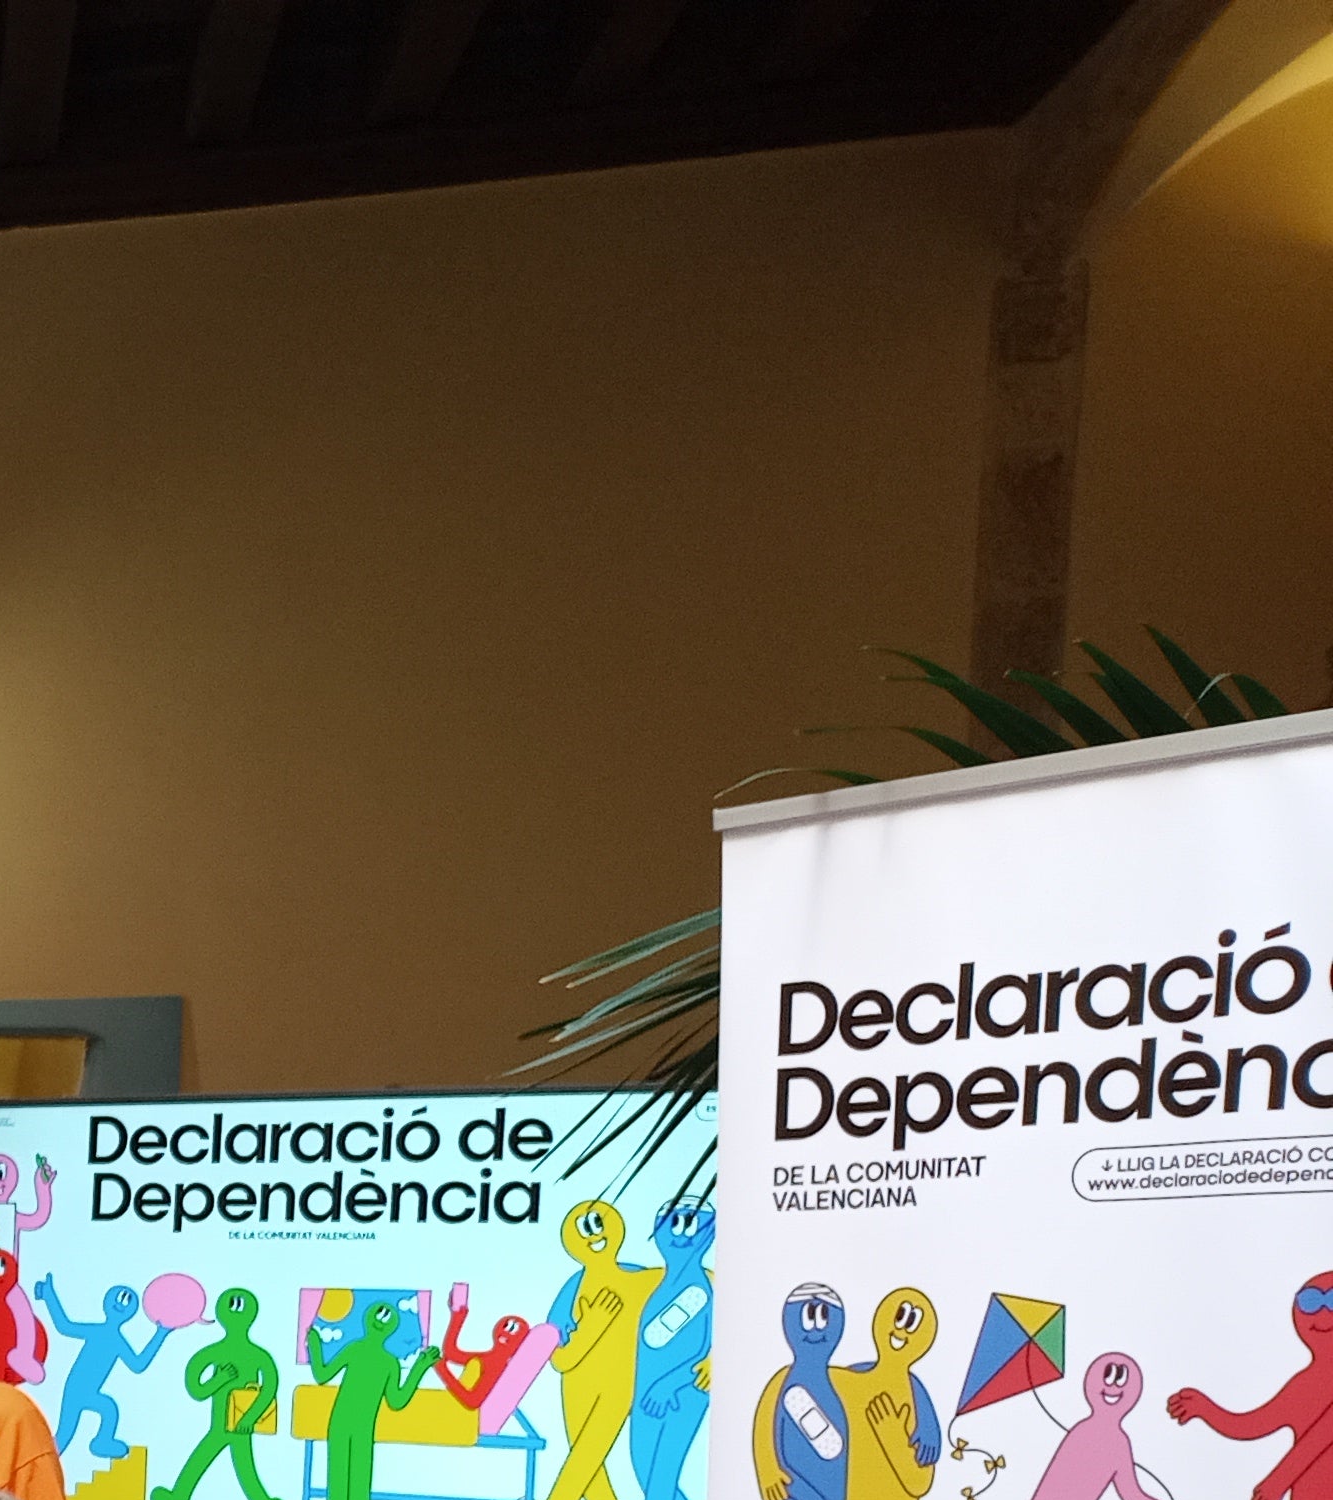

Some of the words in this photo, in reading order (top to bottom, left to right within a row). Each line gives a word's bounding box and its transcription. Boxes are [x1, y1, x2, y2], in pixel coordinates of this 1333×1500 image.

[777, 921, 1311, 1056] Declaració
[775, 1030, 1333, 1152] Dependènc
[88, 1106, 440, 1166] Declaració
[458, 1107, 554, 1164] de
[1159, 1154, 1180, 1170] LA
[1184, 1145, 1303, 1169] DECLARACIÓ
[773, 1165, 804, 1187] DE
[811, 1164, 840, 1185] LA
[846, 1155, 987, 1184] COMUNITAT
[1088, 1168, 1333, 1190] www.declaraciodedepen
[91, 1167, 541, 1233] Dependència
[773, 1186, 917, 1211] VALENCIANA
